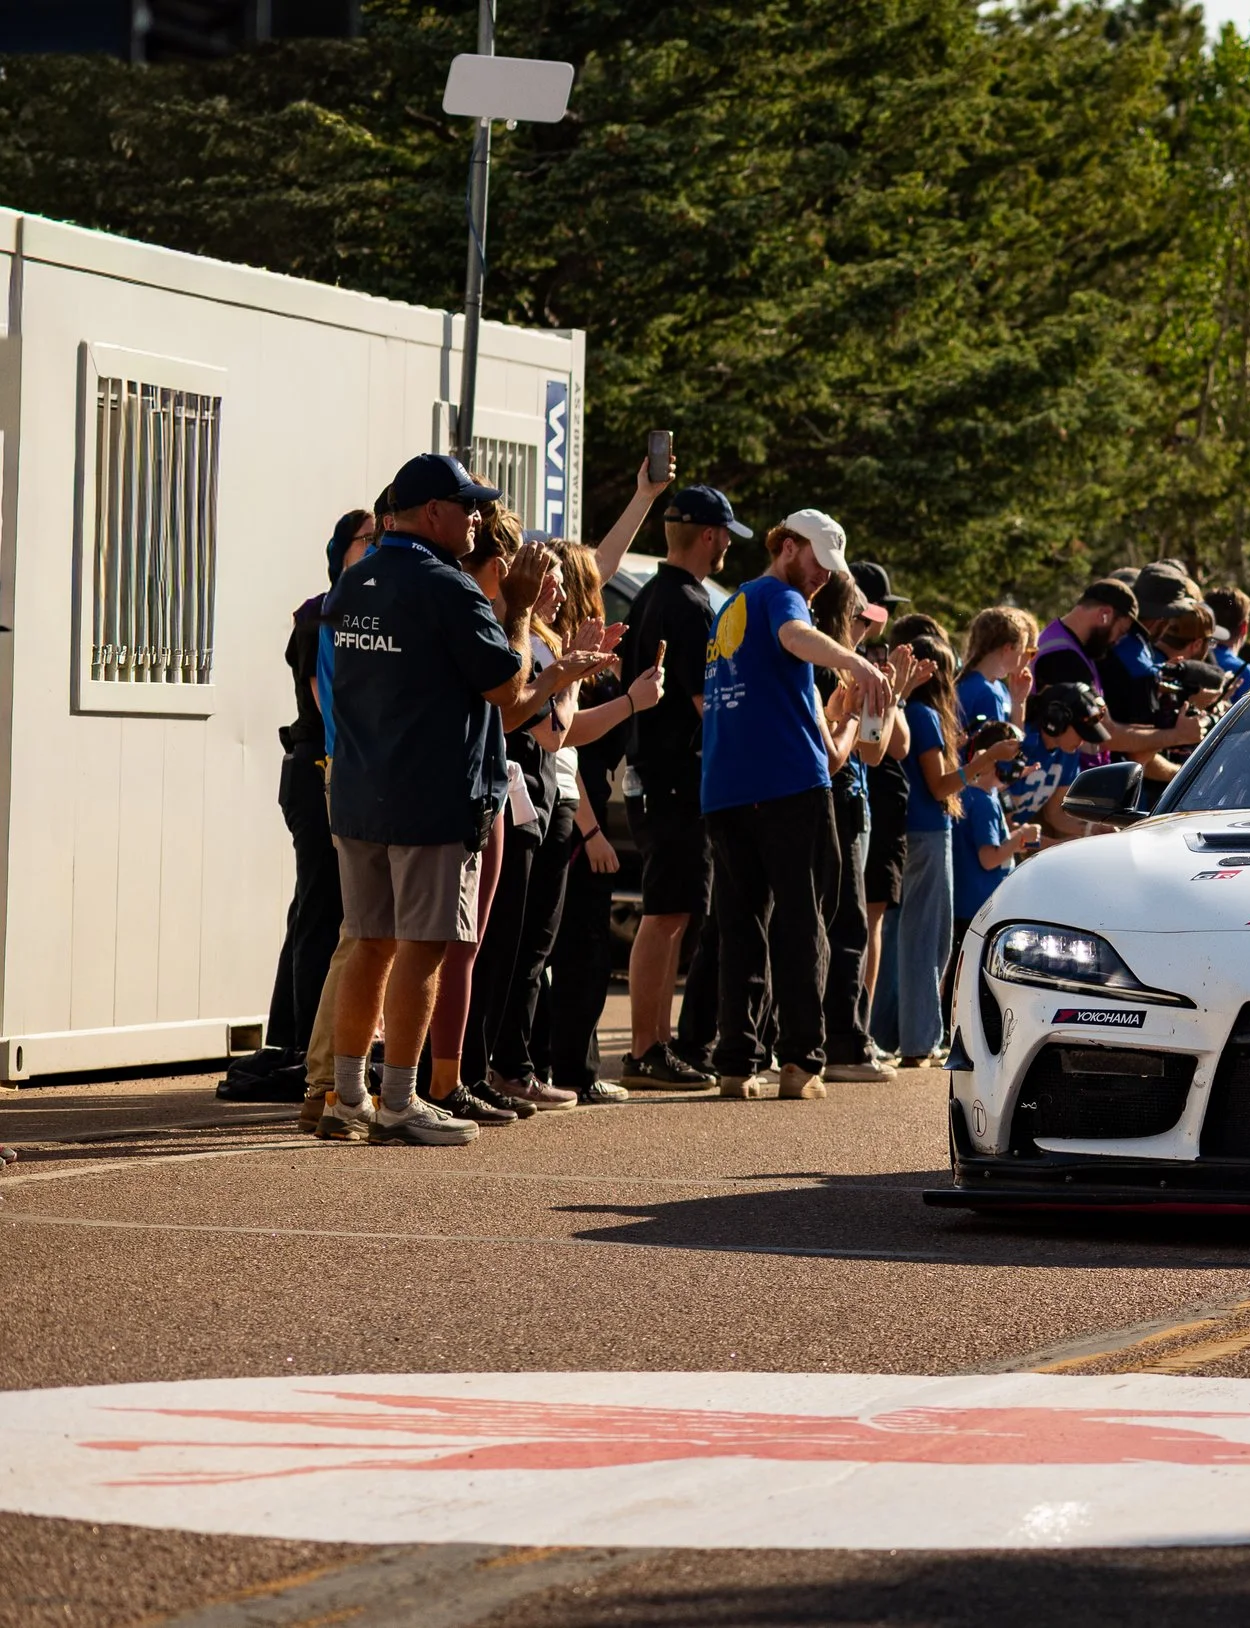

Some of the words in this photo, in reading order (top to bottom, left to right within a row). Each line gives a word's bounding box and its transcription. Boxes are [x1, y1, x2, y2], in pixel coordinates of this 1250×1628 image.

[342, 614, 380, 630] RACE
[334, 631, 402, 652] OFFICIAL
[1077, 1011, 1139, 1025] YOKOHAMA
